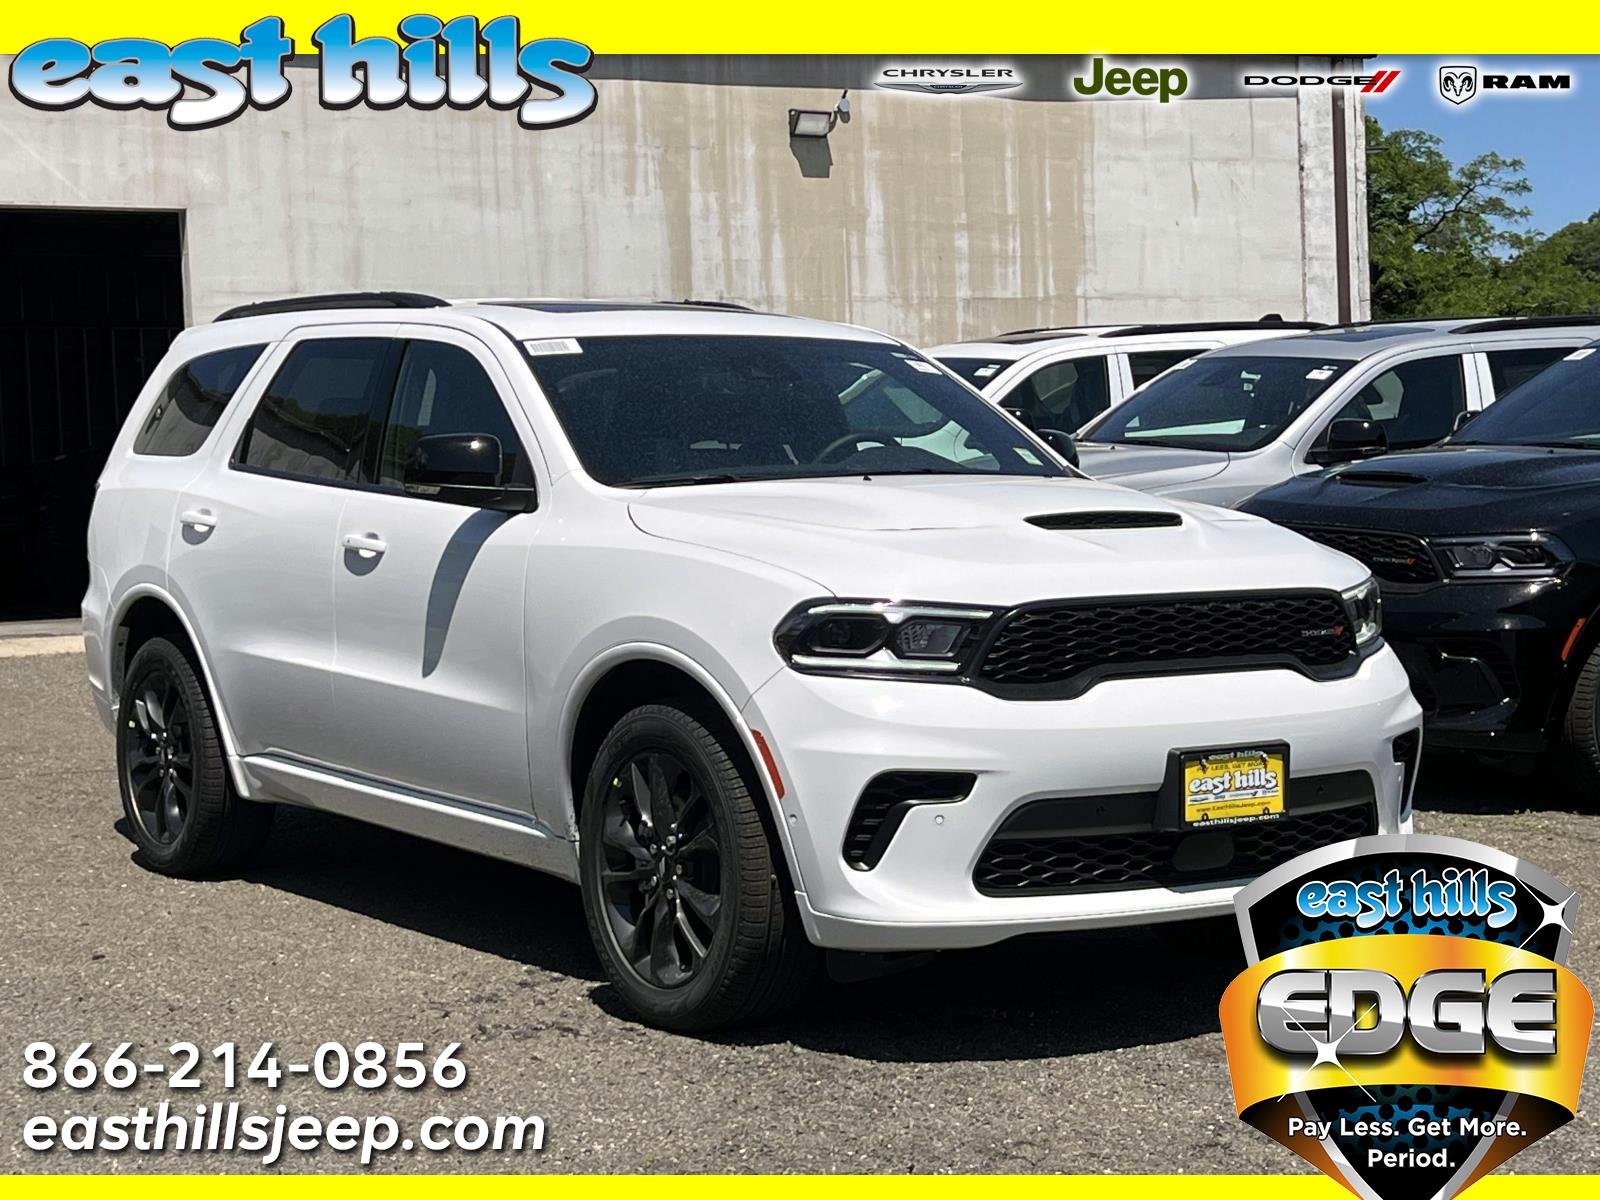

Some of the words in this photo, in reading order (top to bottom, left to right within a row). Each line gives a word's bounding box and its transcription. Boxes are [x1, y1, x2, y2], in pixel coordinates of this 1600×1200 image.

[1189, 771, 1232, 795] east
[1234, 768, 1278, 790] hills
[1192, 813, 1280, 827] easthillsjeep.com
